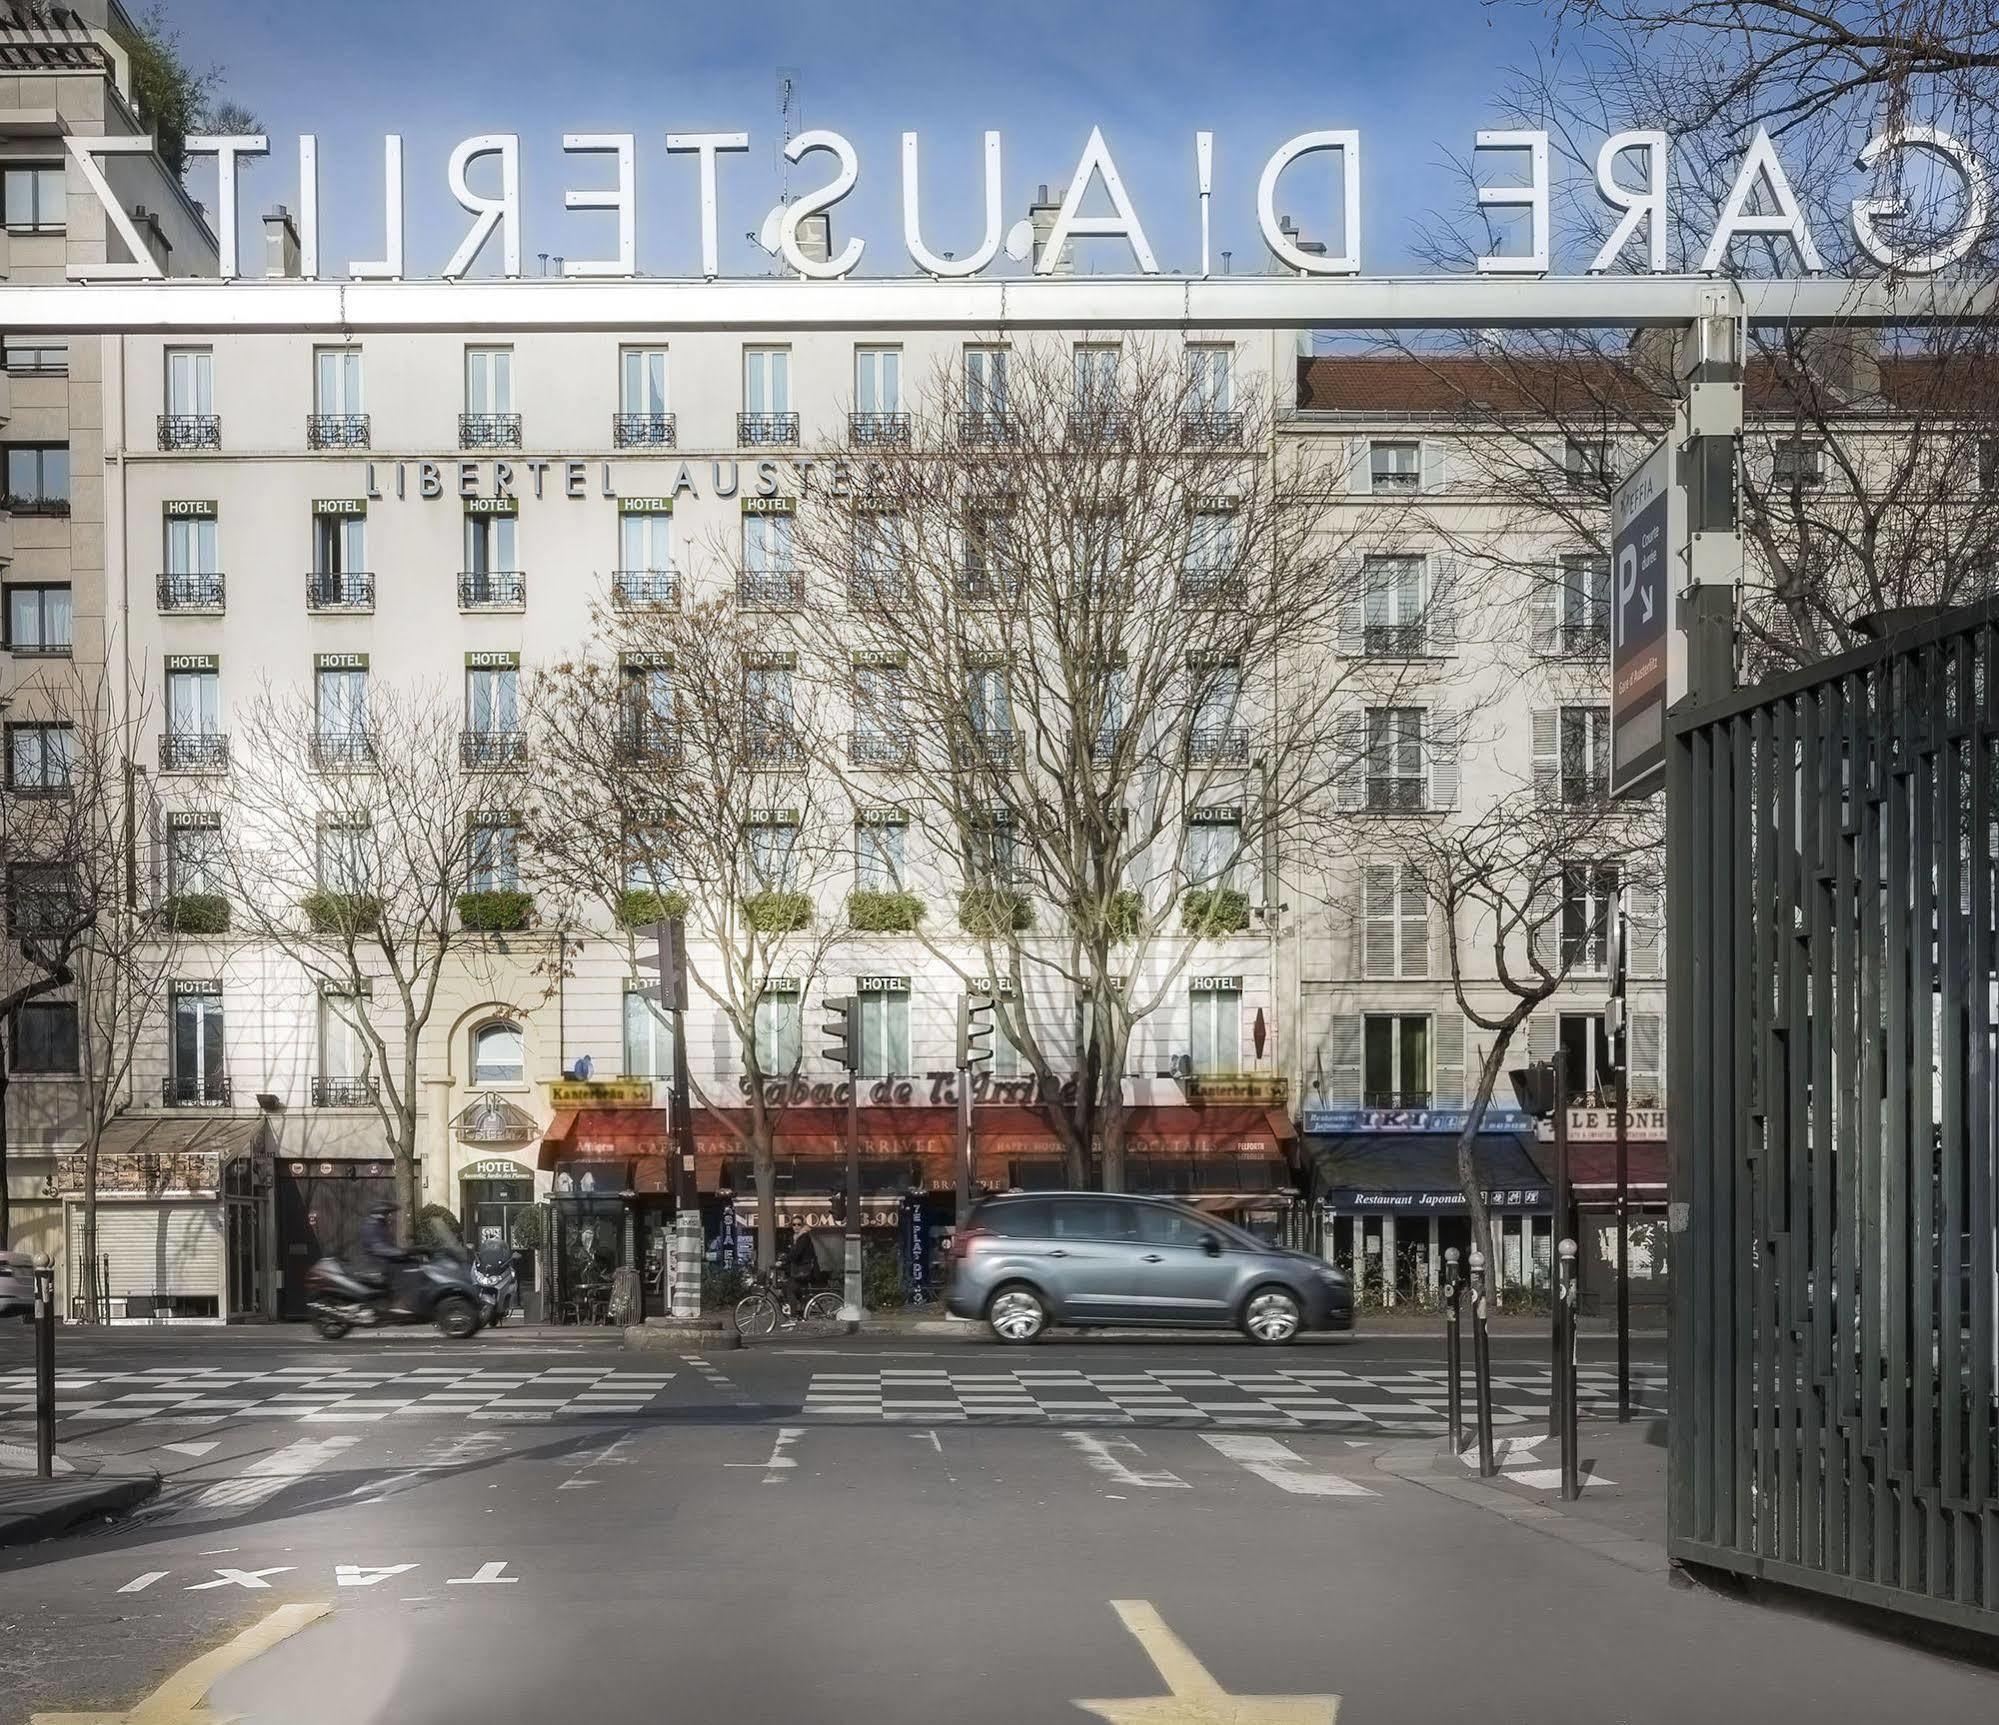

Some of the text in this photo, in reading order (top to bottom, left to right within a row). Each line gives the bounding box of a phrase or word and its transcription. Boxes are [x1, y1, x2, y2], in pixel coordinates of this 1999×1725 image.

[366, 459, 618, 498] LIBERTEL
[1629, 476, 1653, 515] EFFIA
[170, 501, 212, 513] HOTEL
[318, 500, 361, 512] HOTEL
[469, 499, 513, 511] HOTEL
[624, 498, 668, 511] HOTEL
[747, 498, 790, 510] HOTEL
[1641, 525, 1660, 549] Courte
[1641, 548, 1658, 571] durée
[170, 655, 213, 668] HOTEL
[320, 654, 363, 667] HOTEL
[471, 653, 515, 665] HOTEL
[625, 653, 667, 665] HOTEL
[173, 813, 214, 825] HOTEL
[863, 810, 903, 822] HOTEL
[1193, 808, 1235, 820] HOTEL
[174, 980, 217, 993] HOTEL
[863, 978, 906, 990] HOTEL
[1194, 977, 1237, 990] HOTEL
[870, 1072, 912, 1105] de
[1571, 1113, 1599, 1128] LE
[476, 1161, 518, 1173] HOTEL
[1354, 1193, 1412, 1205] Restaurant
[1418, 1192, 1466, 1207] Japonais
[116, 1560, 520, 1593] TAXI
